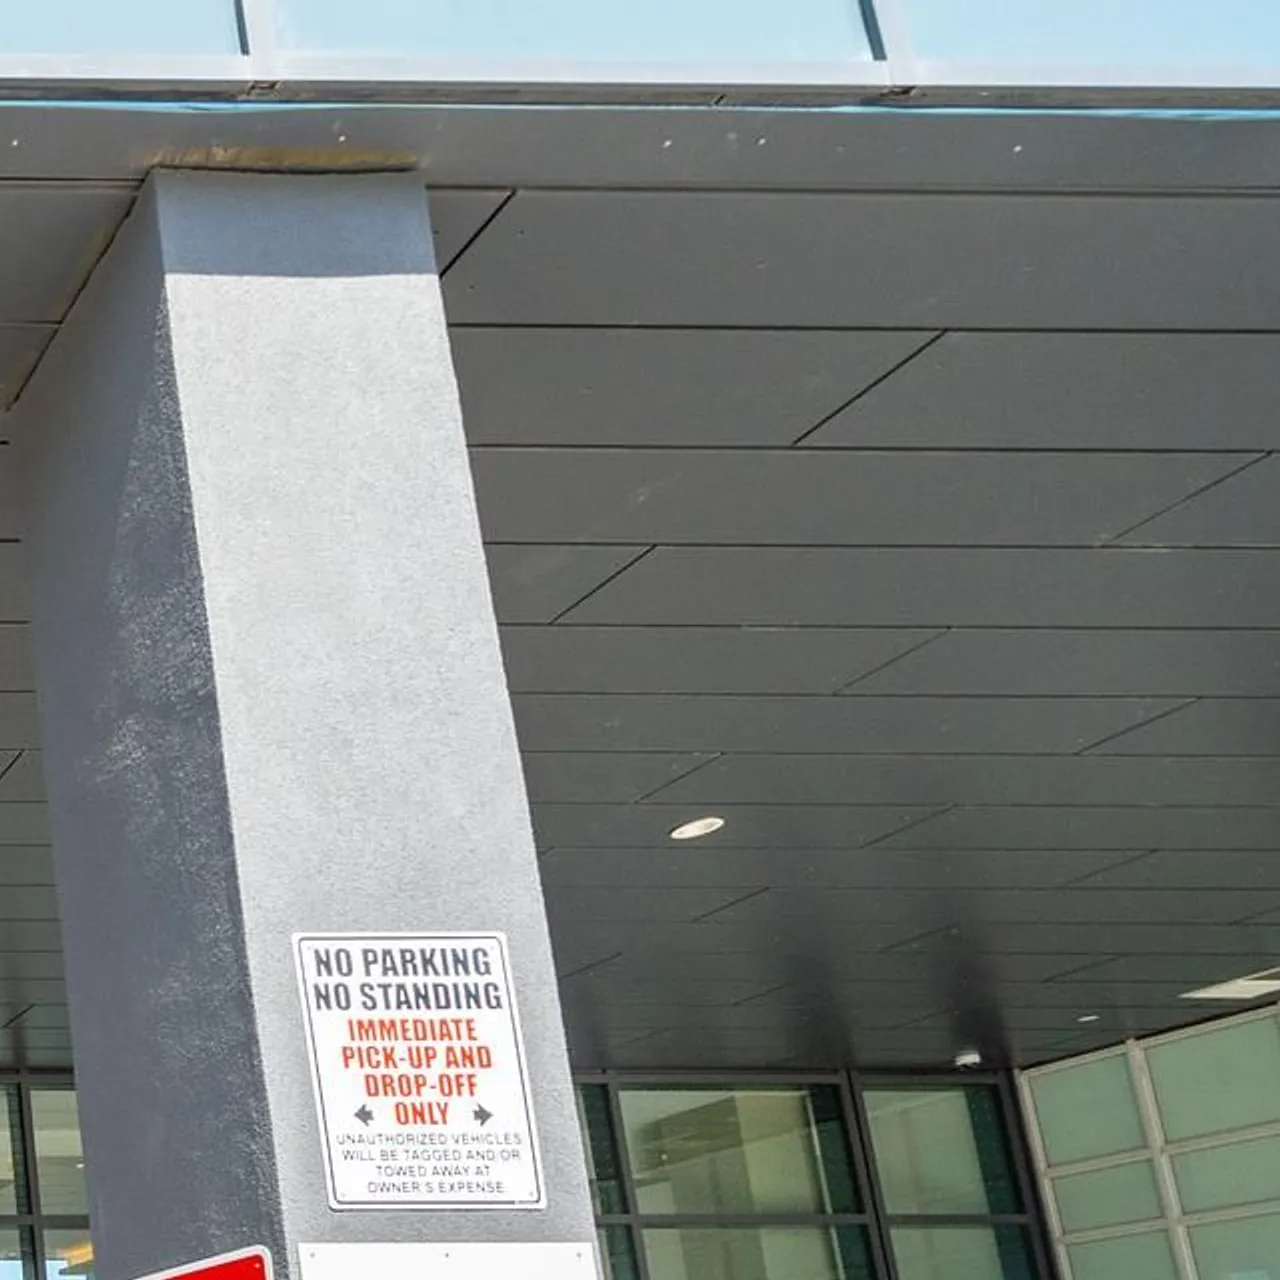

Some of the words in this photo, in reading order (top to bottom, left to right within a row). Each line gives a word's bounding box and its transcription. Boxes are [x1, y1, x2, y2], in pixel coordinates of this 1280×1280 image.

[313, 948, 353, 977] NO
[361, 947, 492, 977] PARKING
[313, 983, 351, 1011] NO
[360, 982, 503, 1011] STANDING
[347, 1018, 478, 1041] IMMEDIATE
[342, 1046, 438, 1069] PICK-UP
[445, 1046, 493, 1069] AND
[364, 1074, 478, 1097] DROP-OFF
[394, 1102, 449, 1125] ONLY
[336, 1133, 447, 1145] UNAUTHORIZED
[451, 1133, 522, 1145] VEHICLES
[342, 1150, 376, 1161] WILL
[380, 1150, 398, 1161] BE
[403, 1150, 462, 1161] TAGGED
[376, 1166, 427, 1177] TOWED
[431, 1166, 470, 1177] AWAY
[475, 1166, 491, 1177] AT
[368, 1182, 433, 1193] OWNER'S
[439, 1182, 504, 1193] EXPENSE
